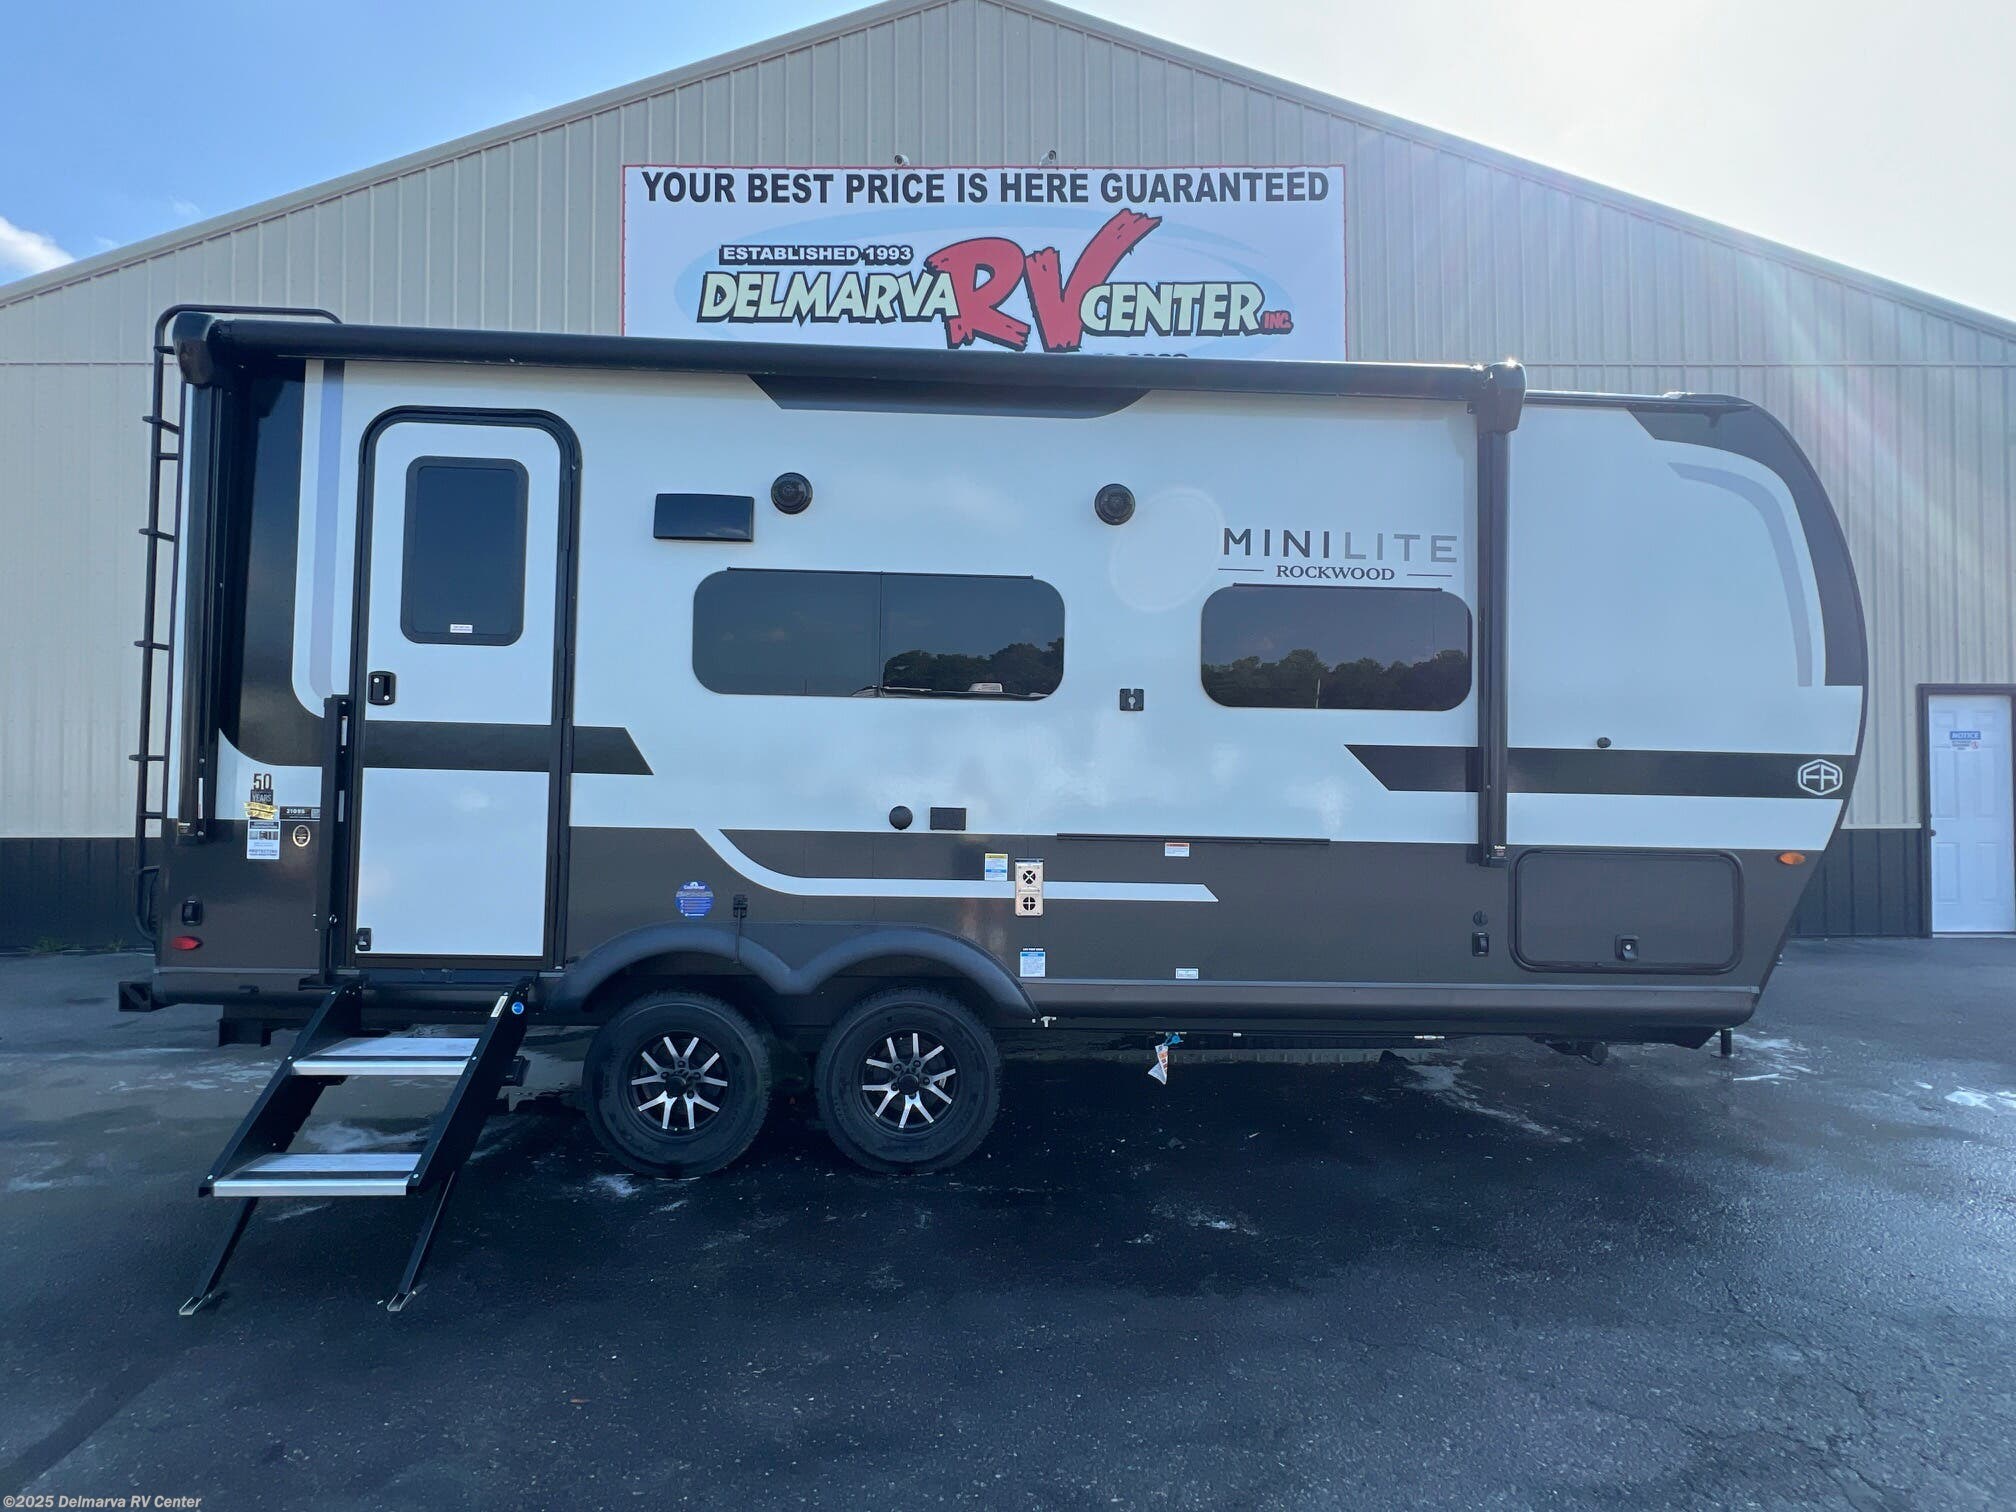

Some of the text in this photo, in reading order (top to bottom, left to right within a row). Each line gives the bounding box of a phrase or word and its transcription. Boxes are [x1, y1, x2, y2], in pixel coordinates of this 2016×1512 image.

[641, 171, 1330, 204] YOUR BEST PRICE IS HERE GUARANTEED
[721, 245, 914, 263] ESTABLISHED 1993
[698, 208, 1293, 352] DELMARVA RV CENTER INC.
[1276, 565, 1395, 581] ROCKWOOD
[253, 773, 273, 791] 50
[251, 793, 272, 802] YEARS
